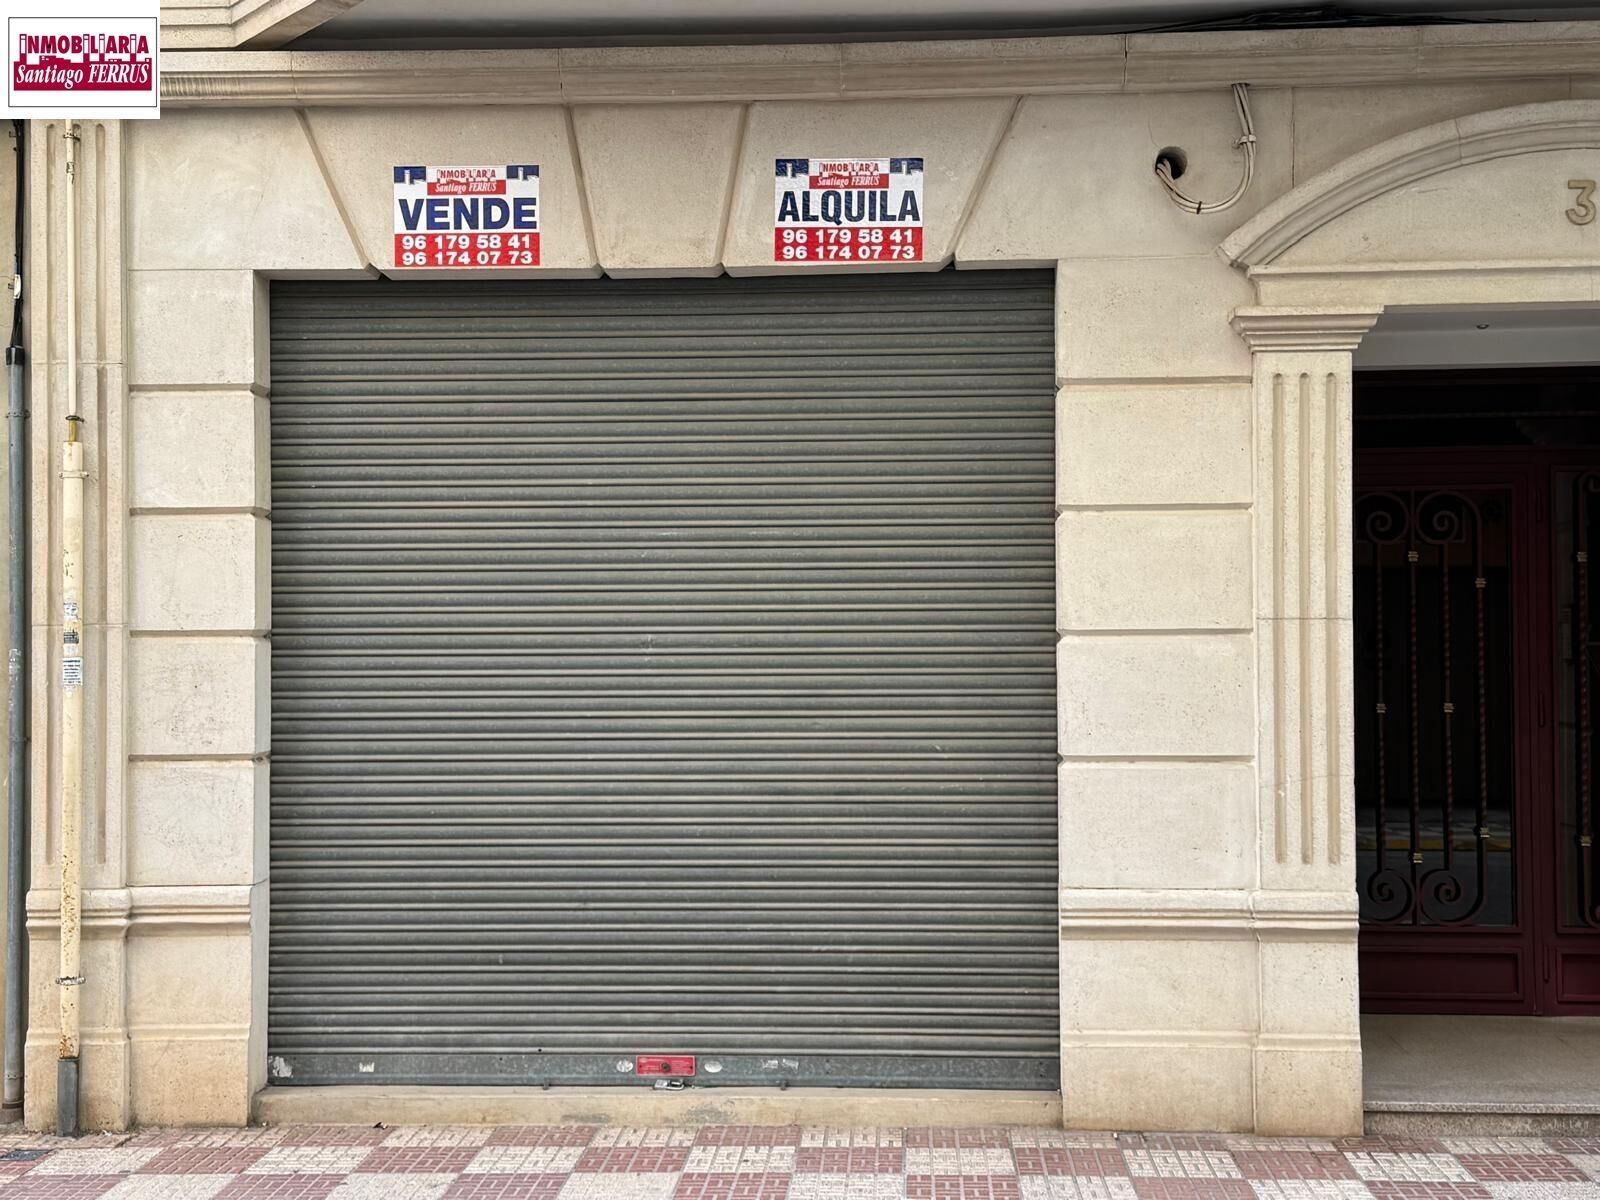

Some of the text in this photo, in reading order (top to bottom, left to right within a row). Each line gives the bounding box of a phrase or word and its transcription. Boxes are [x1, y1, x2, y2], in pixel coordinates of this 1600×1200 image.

[435, 182, 497, 194] Santiago FERRUS
[817, 175, 880, 188] Santiago FERRUS
[777, 190, 921, 226] ALQUILA
[1565, 179, 1597, 226] 3
[398, 197, 537, 231] VENDE
[402, 234, 531, 250] 96 179 58 41
[782, 228, 913, 243] 96 179 58 41
[402, 250, 533, 265] 96 174 07 73
[782, 245, 915, 259] 96 174 07 73
